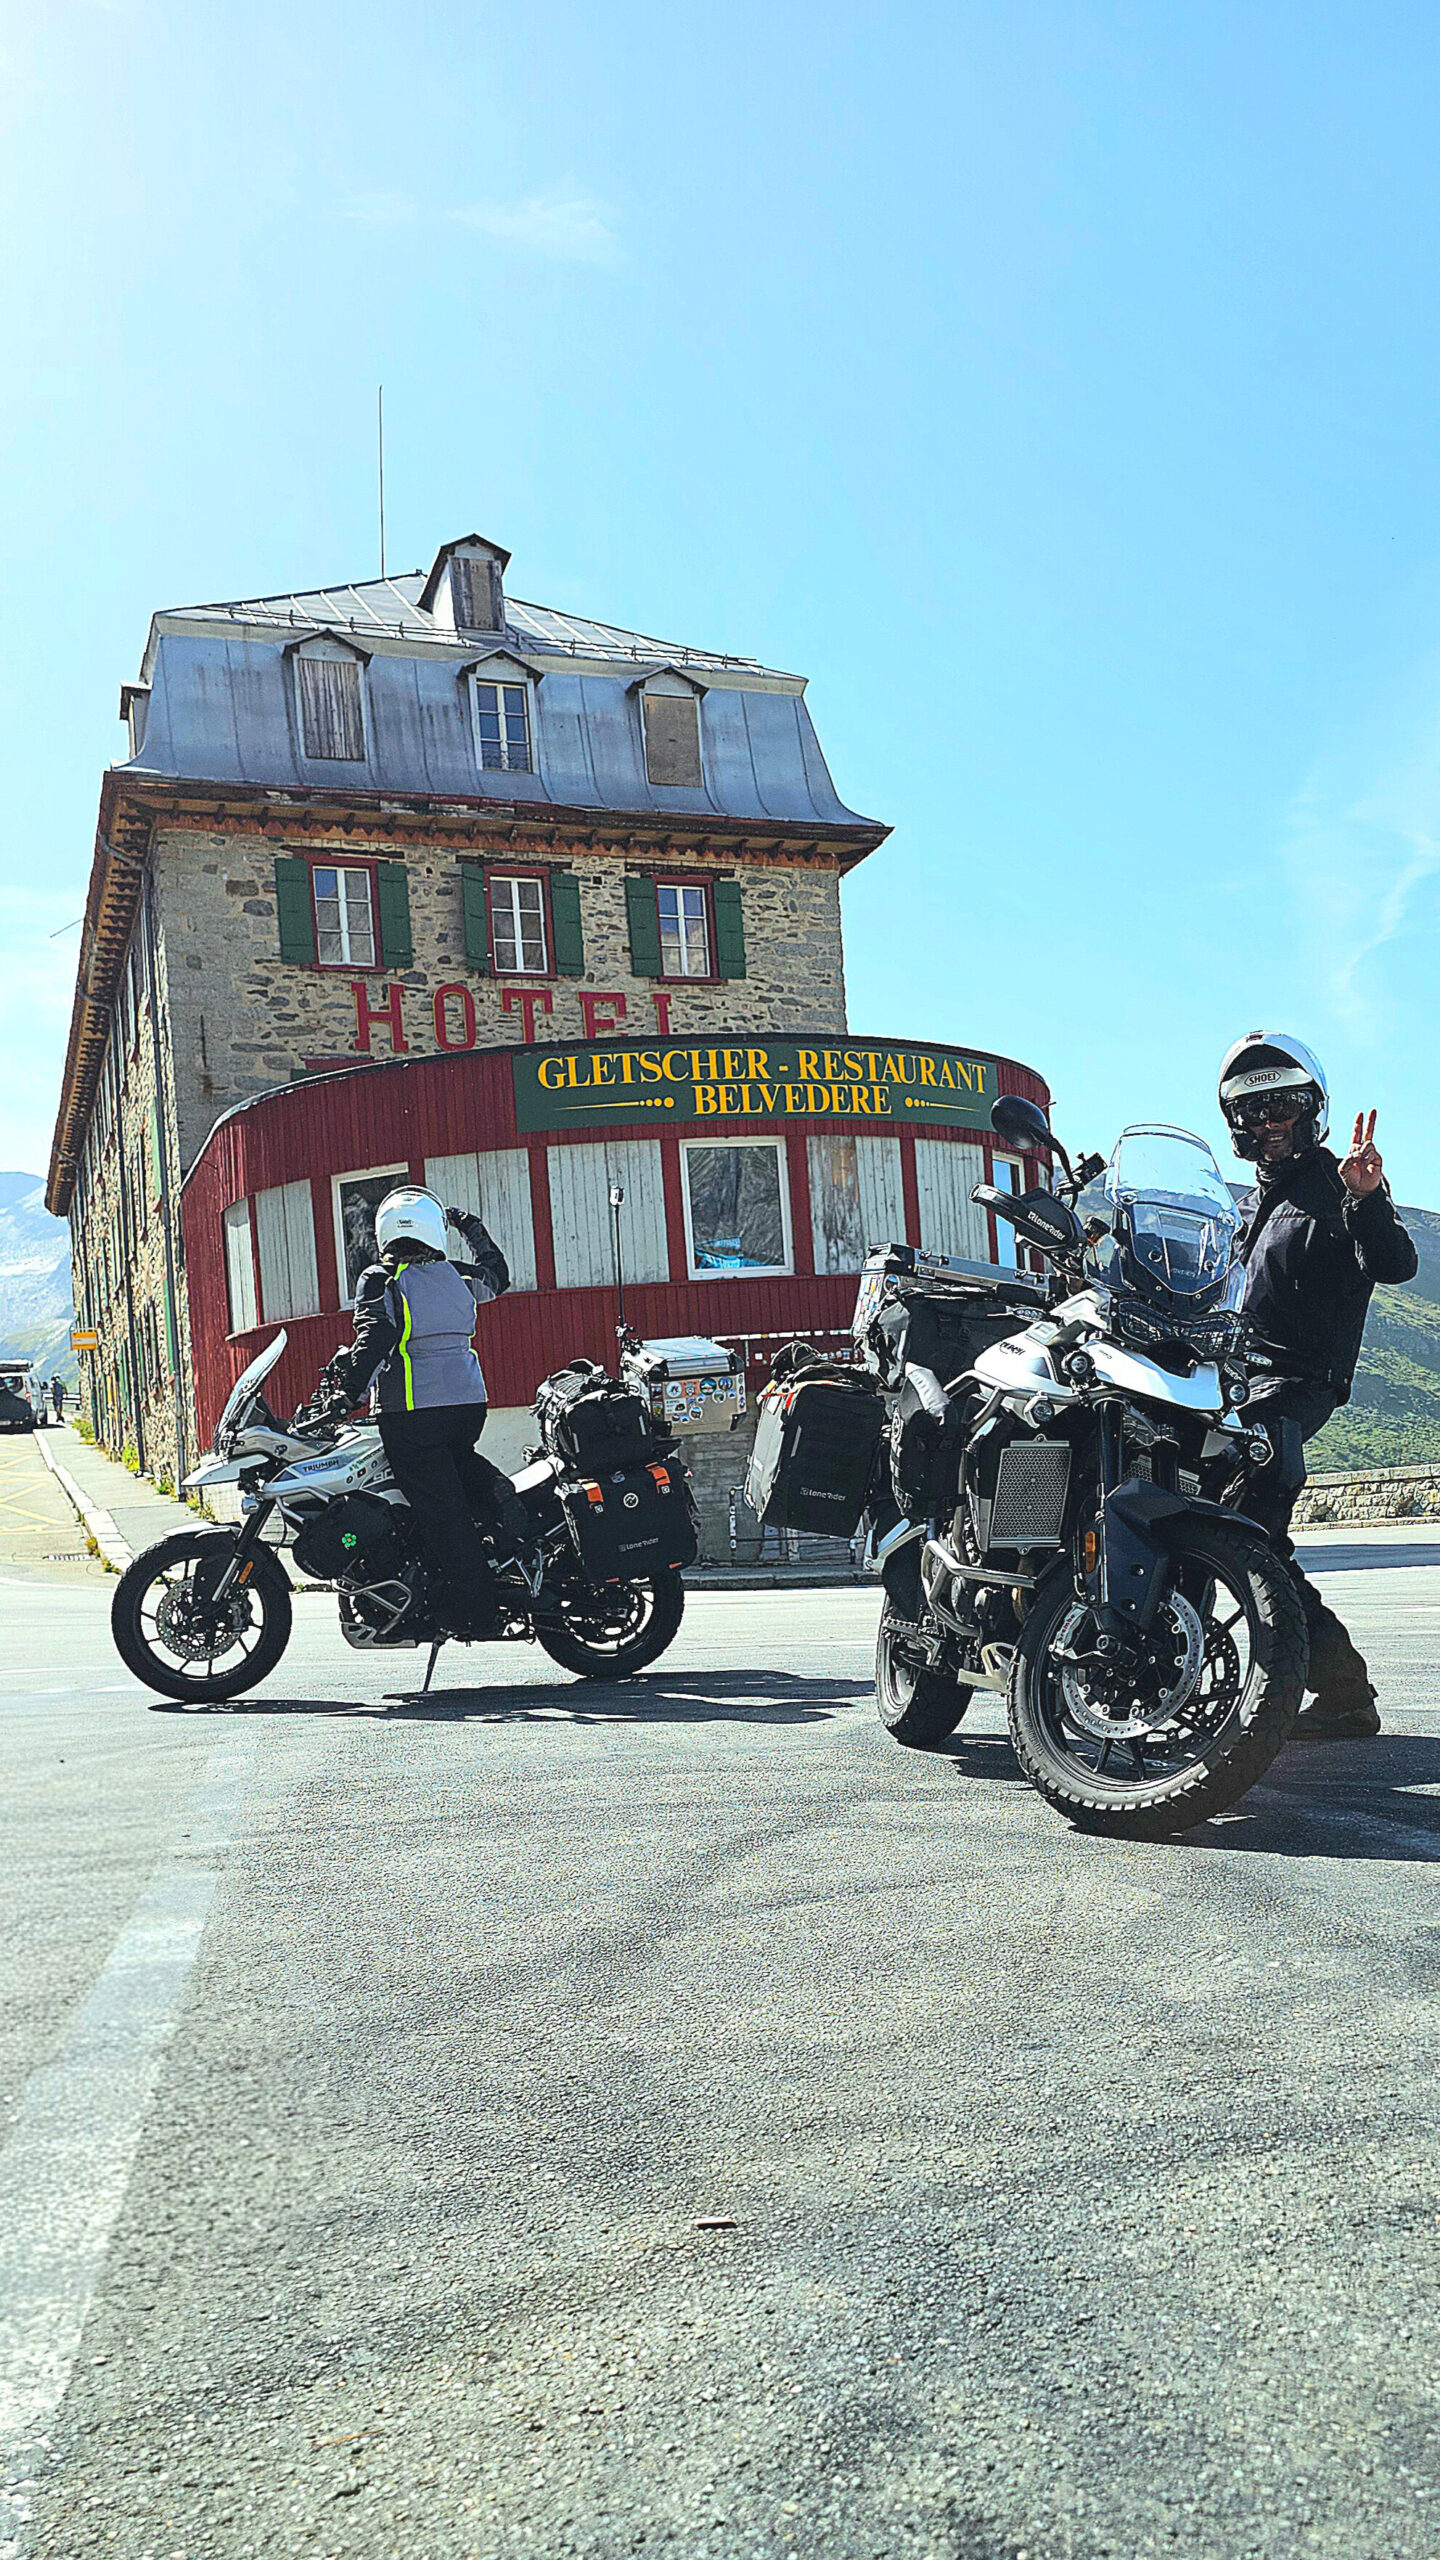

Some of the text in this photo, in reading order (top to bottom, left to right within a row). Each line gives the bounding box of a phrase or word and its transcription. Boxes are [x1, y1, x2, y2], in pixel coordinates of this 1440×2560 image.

[537, 1048, 773, 1090] GLETSCHER
[796, 1049, 987, 1094] RESTAURANT
[1249, 1072, 1276, 1085] SHOEI
[692, 1083, 893, 1115] BELVEDERE
[303, 1459, 339, 1472] TRIUMPH
